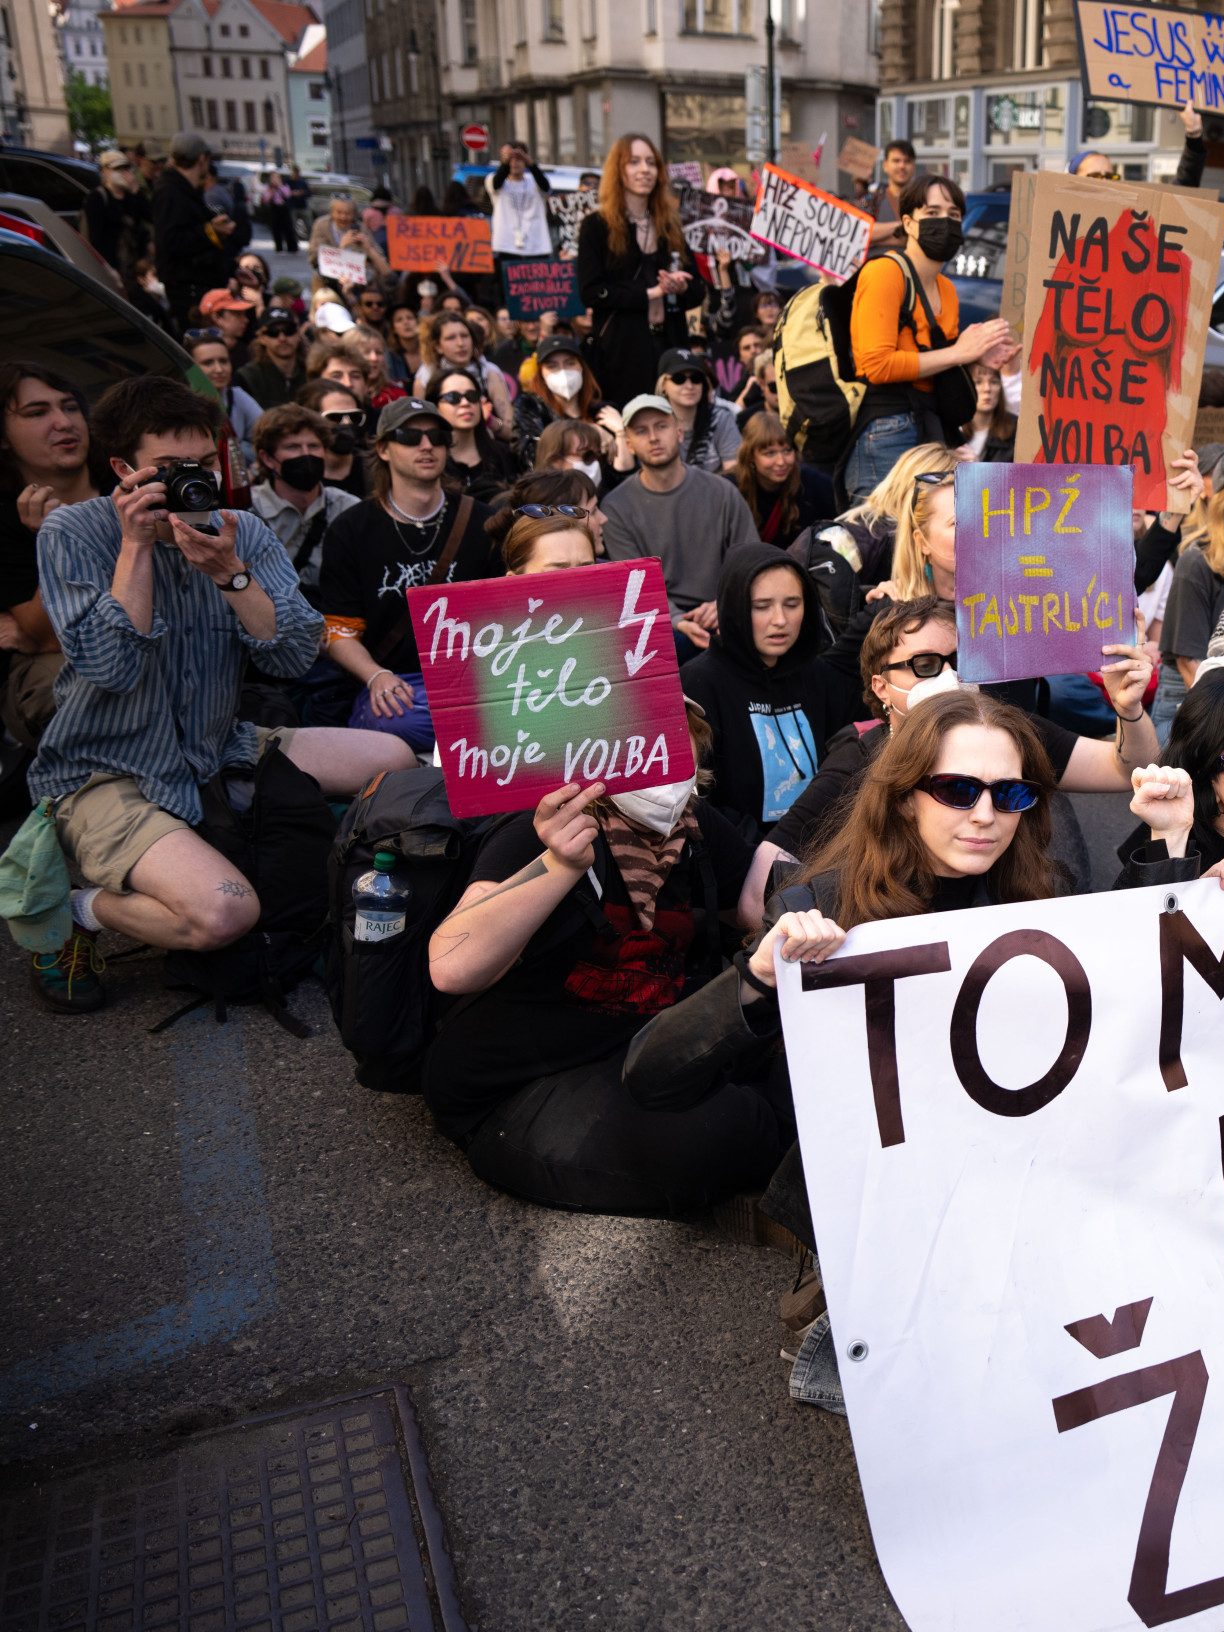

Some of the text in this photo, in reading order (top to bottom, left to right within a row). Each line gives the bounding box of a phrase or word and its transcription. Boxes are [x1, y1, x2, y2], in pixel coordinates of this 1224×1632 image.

[1093, 9, 1196, 67] JESUS
[398, 240, 493, 269] JSEM NE
[1048, 209, 1188, 274] NAŠE
[1042, 273, 1171, 343] TĚLO
[1040, 347, 1148, 405] NAŠE
[423, 597, 584, 676] moje
[507, 657, 611, 716] tělo
[450, 729, 669, 787] moje VOLBA
[366, 920, 401, 935] RAJEC
[800, 928, 1093, 1149] TO
